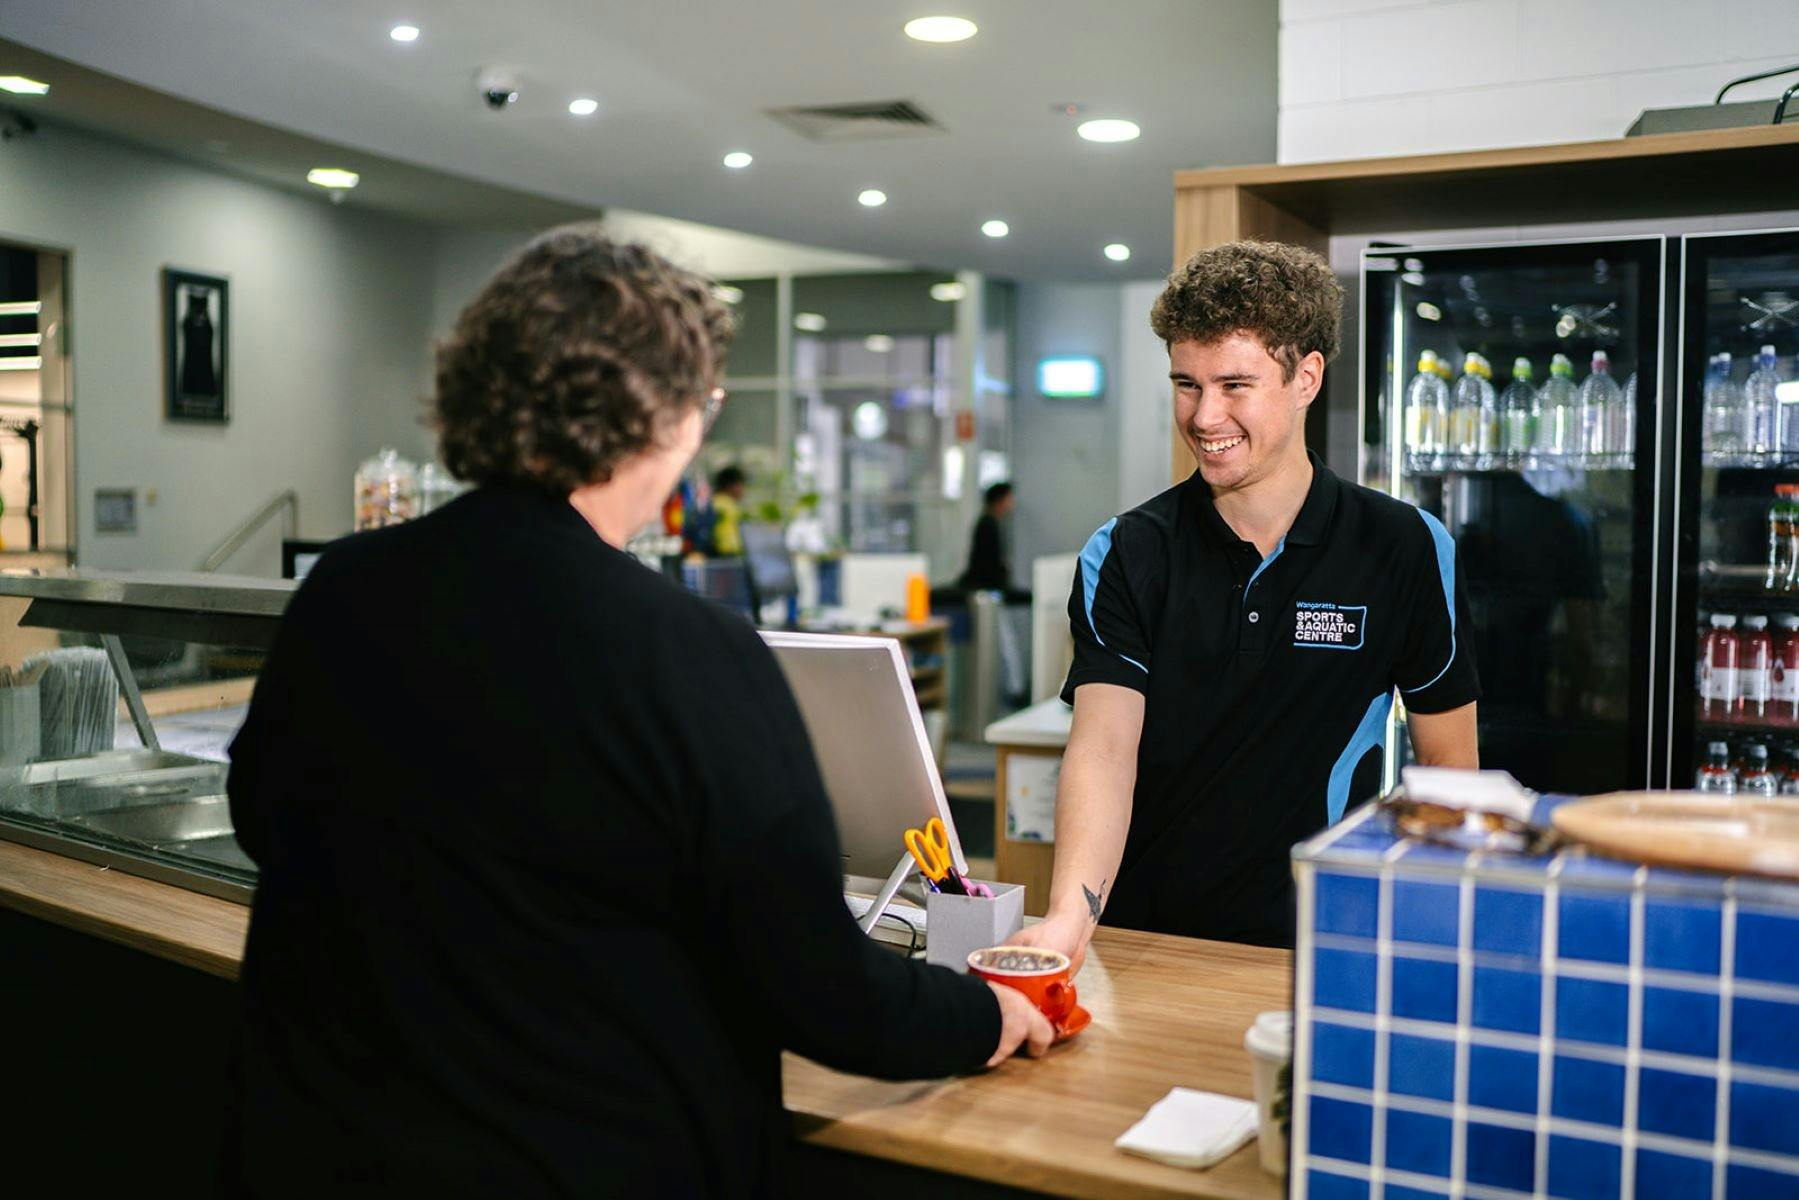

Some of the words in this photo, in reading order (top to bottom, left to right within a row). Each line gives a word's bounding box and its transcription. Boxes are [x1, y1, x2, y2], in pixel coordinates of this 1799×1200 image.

[1296, 601, 1336, 609] Wangaratta
[1296, 611, 1344, 622] SPORTS
[1295, 632, 1343, 642] CENTRE
